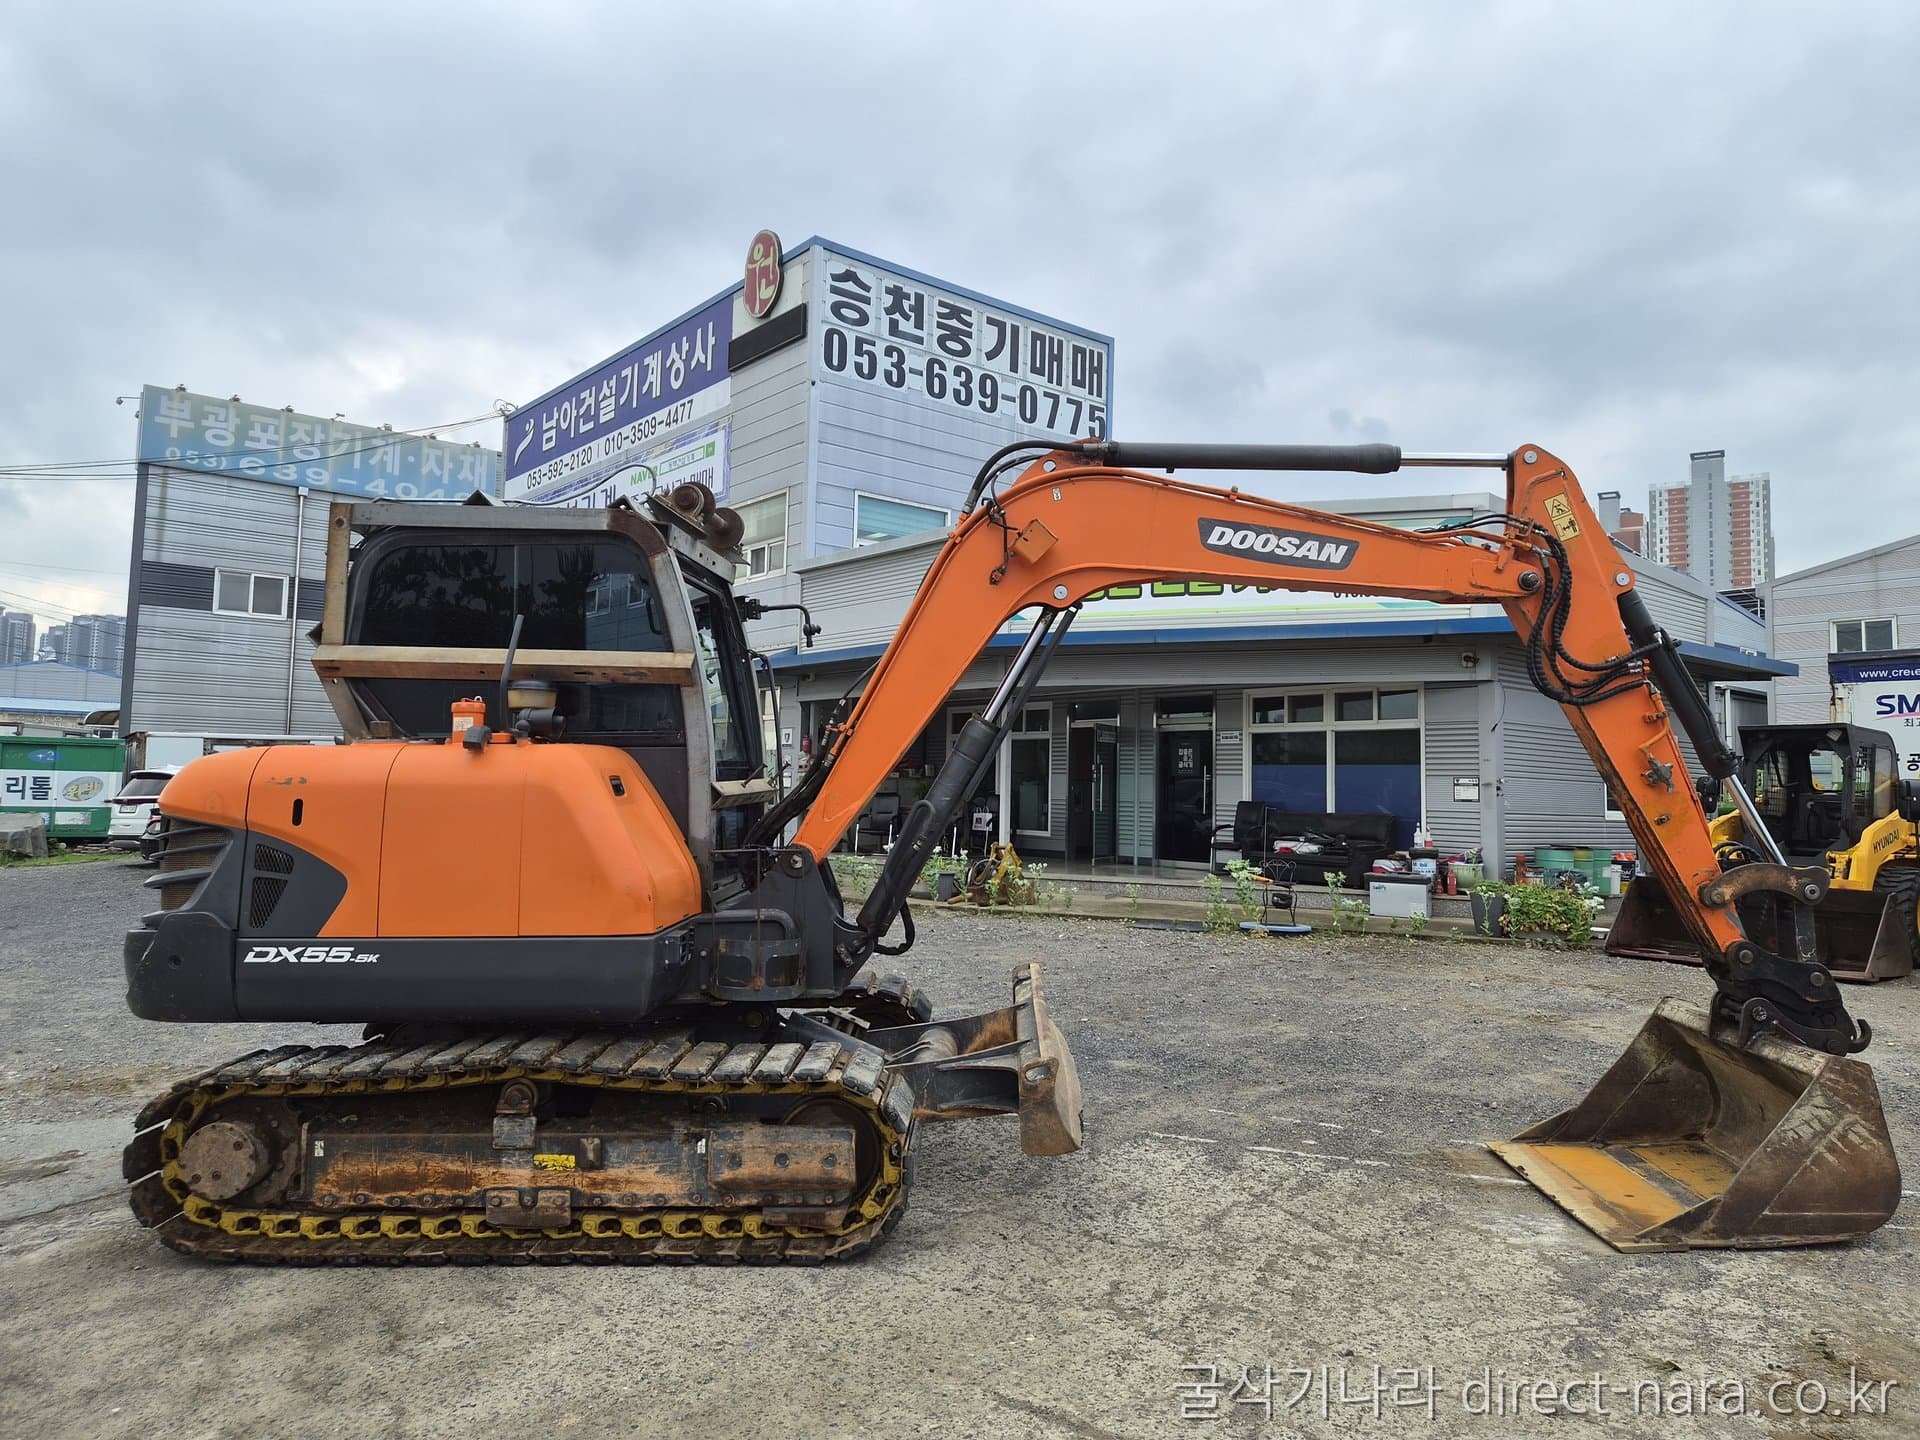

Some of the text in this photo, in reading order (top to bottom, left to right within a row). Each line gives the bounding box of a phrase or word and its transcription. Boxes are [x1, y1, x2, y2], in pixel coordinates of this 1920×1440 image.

[830, 268, 1104, 398] 승천중기매매
[541, 321, 716, 452] 남아건설기계상사
[823, 328, 1106, 441] 053-639-0775
[527, 398, 695, 490] 053-592-2120 010-3509-4477
[1206, 525, 1350, 566] DOOSAN
[1872, 828, 1900, 855] HYUNDAI
